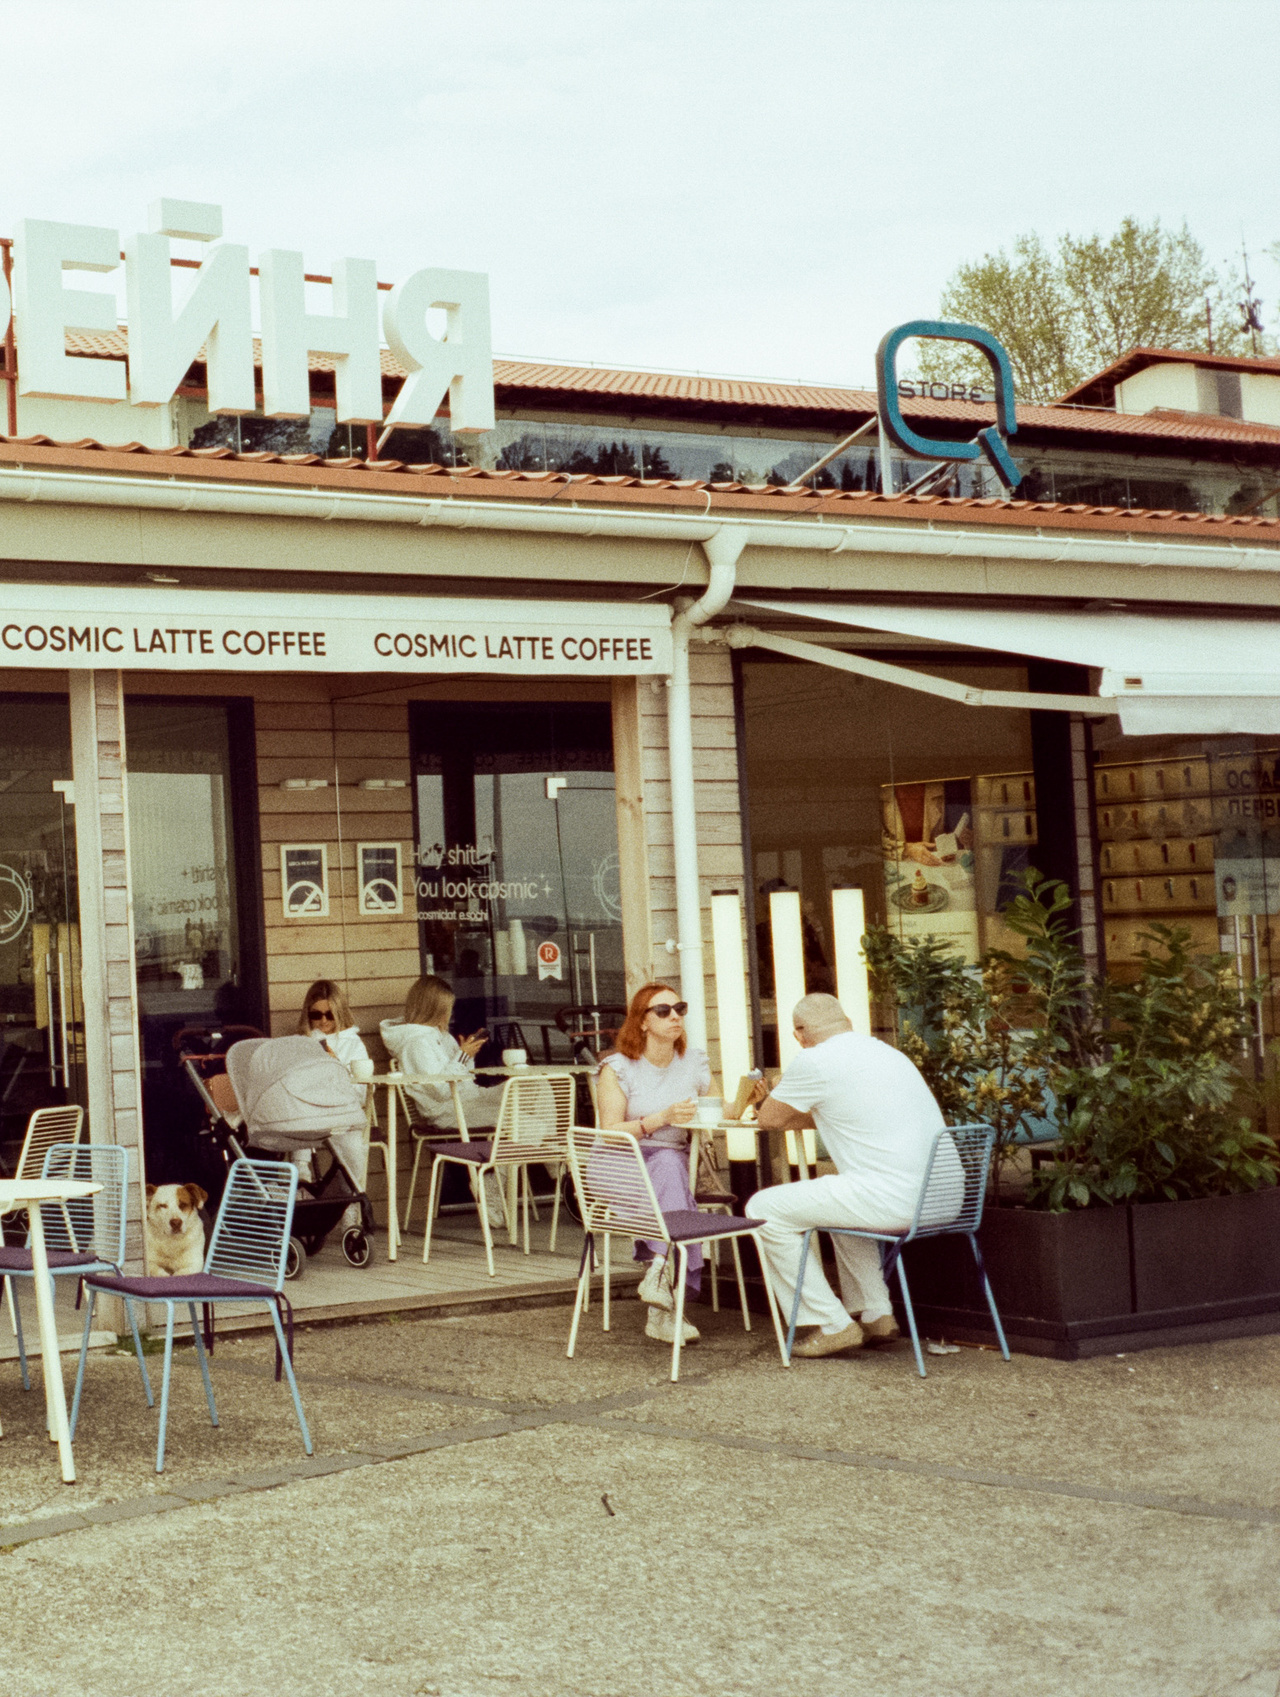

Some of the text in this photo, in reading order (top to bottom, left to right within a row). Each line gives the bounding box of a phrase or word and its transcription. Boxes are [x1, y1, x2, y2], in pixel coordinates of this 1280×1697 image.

[898, 379, 987, 405] STORE
[1, 624, 327, 656] COSMIC LATTE COFFEE
[374, 632, 653, 661] COSMIC LATTE COFFEE
[410, 876, 539, 900] You look cosmic
